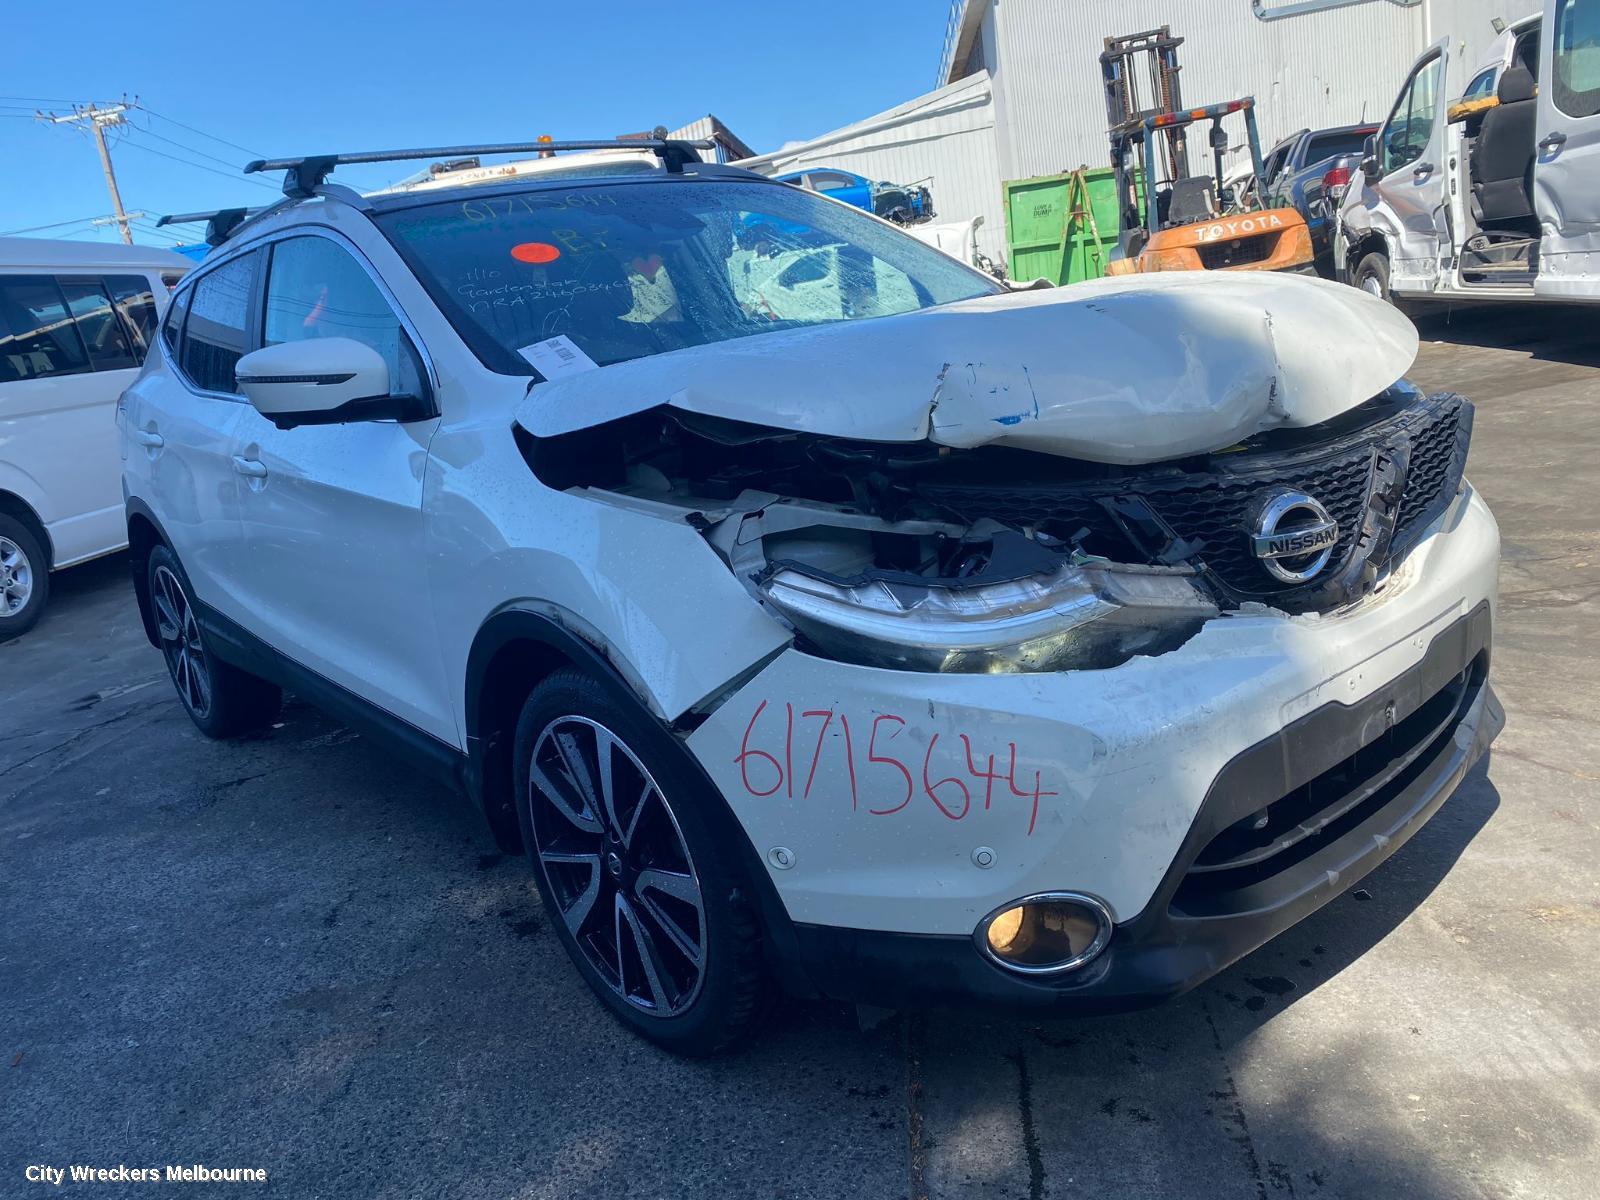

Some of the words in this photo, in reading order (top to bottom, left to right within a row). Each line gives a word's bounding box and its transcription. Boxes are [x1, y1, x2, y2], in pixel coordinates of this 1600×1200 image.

[1194, 214, 1283, 242] TOYOTA
[1268, 527, 1336, 554] NISSAN
[734, 699, 1059, 836] 61715644
